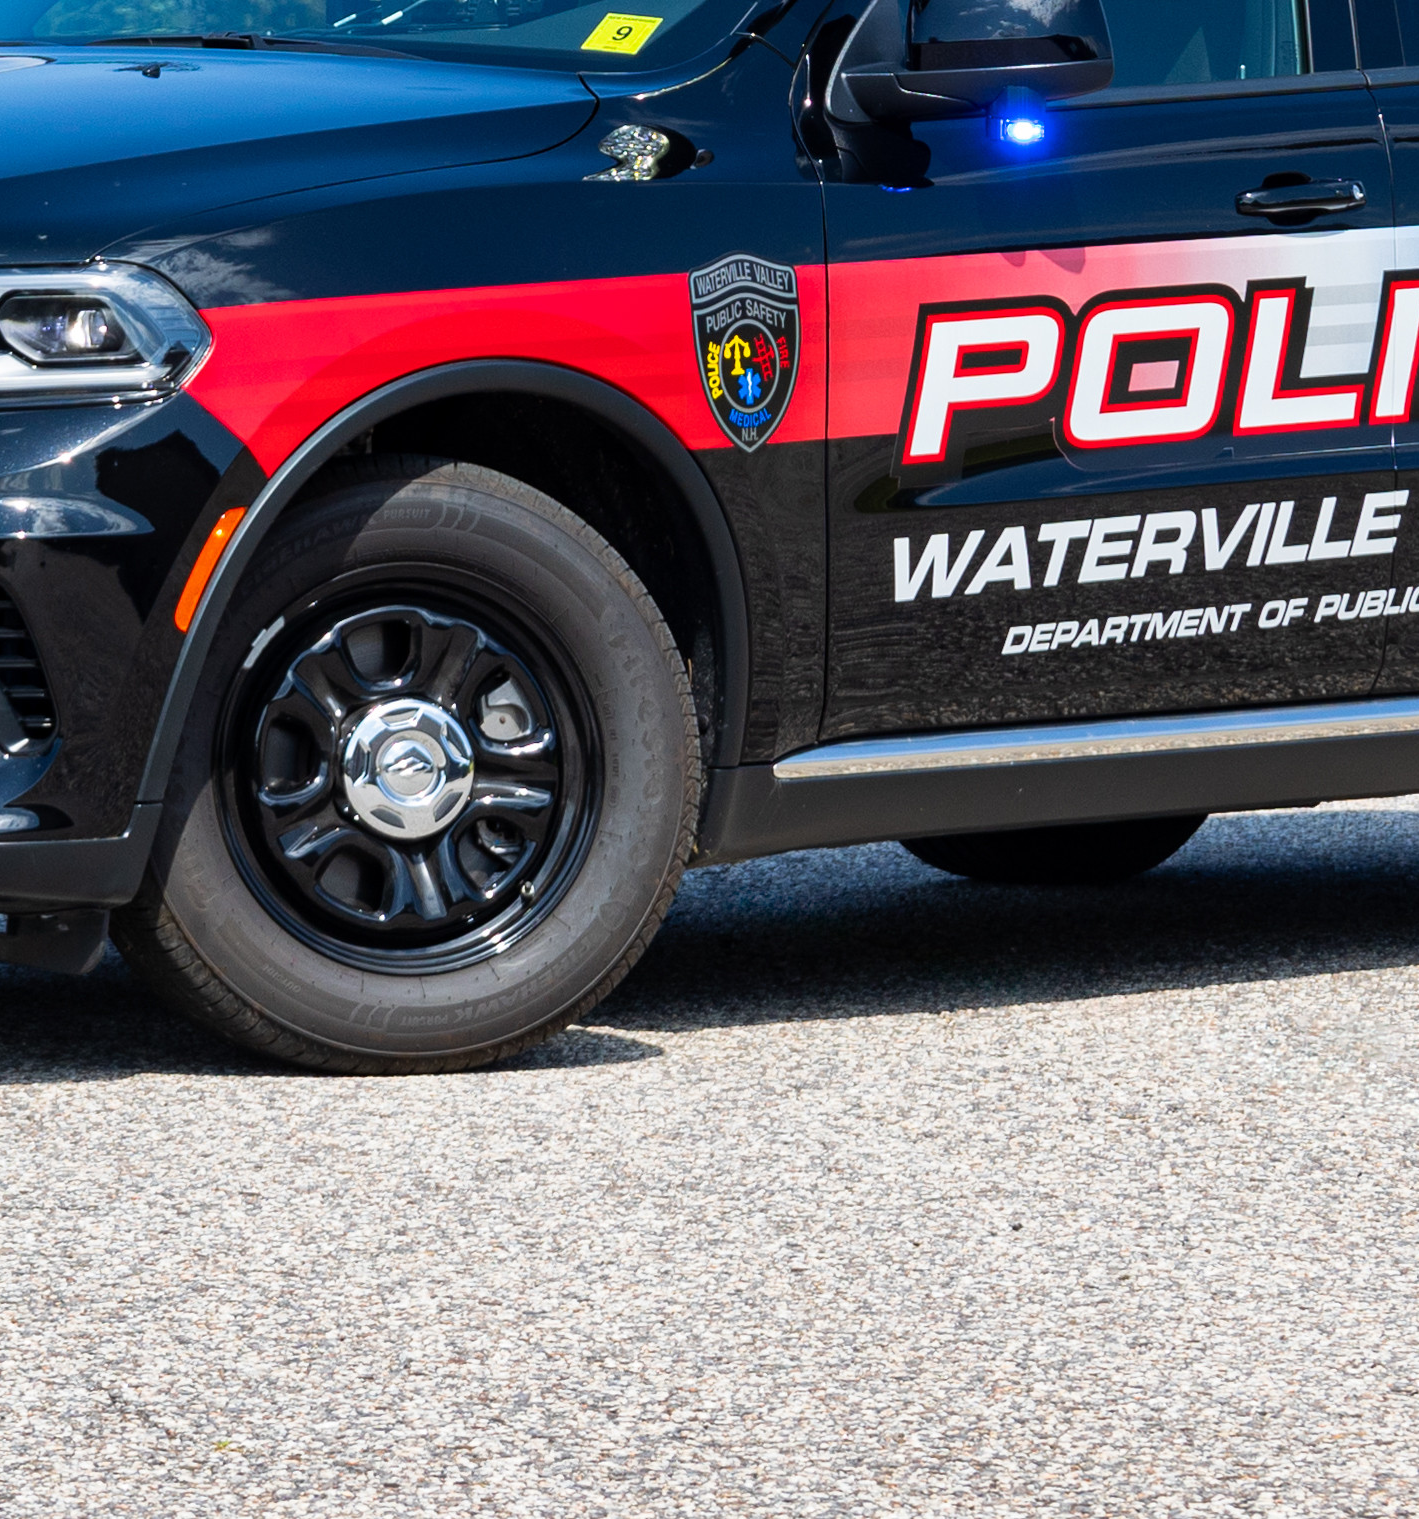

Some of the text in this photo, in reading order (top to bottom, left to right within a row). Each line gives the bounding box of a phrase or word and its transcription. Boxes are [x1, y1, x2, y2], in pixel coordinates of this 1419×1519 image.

[611, 25, 633, 42] 9
[695, 262, 790, 296] WATERVILLE VALLEY
[705, 299, 787, 334] PUBLIC SAFETY
[776, 336, 790, 369] FIRE
[706, 341, 724, 400] POLICE
[728, 407, 772, 428] MEDICAL
[383, 507, 432, 521] PURSUIT
[892, 488, 1409, 603] WATERVILLE
[1000, 600, 1254, 655] DEPARTMENT
[1257, 596, 1310, 632] OF
